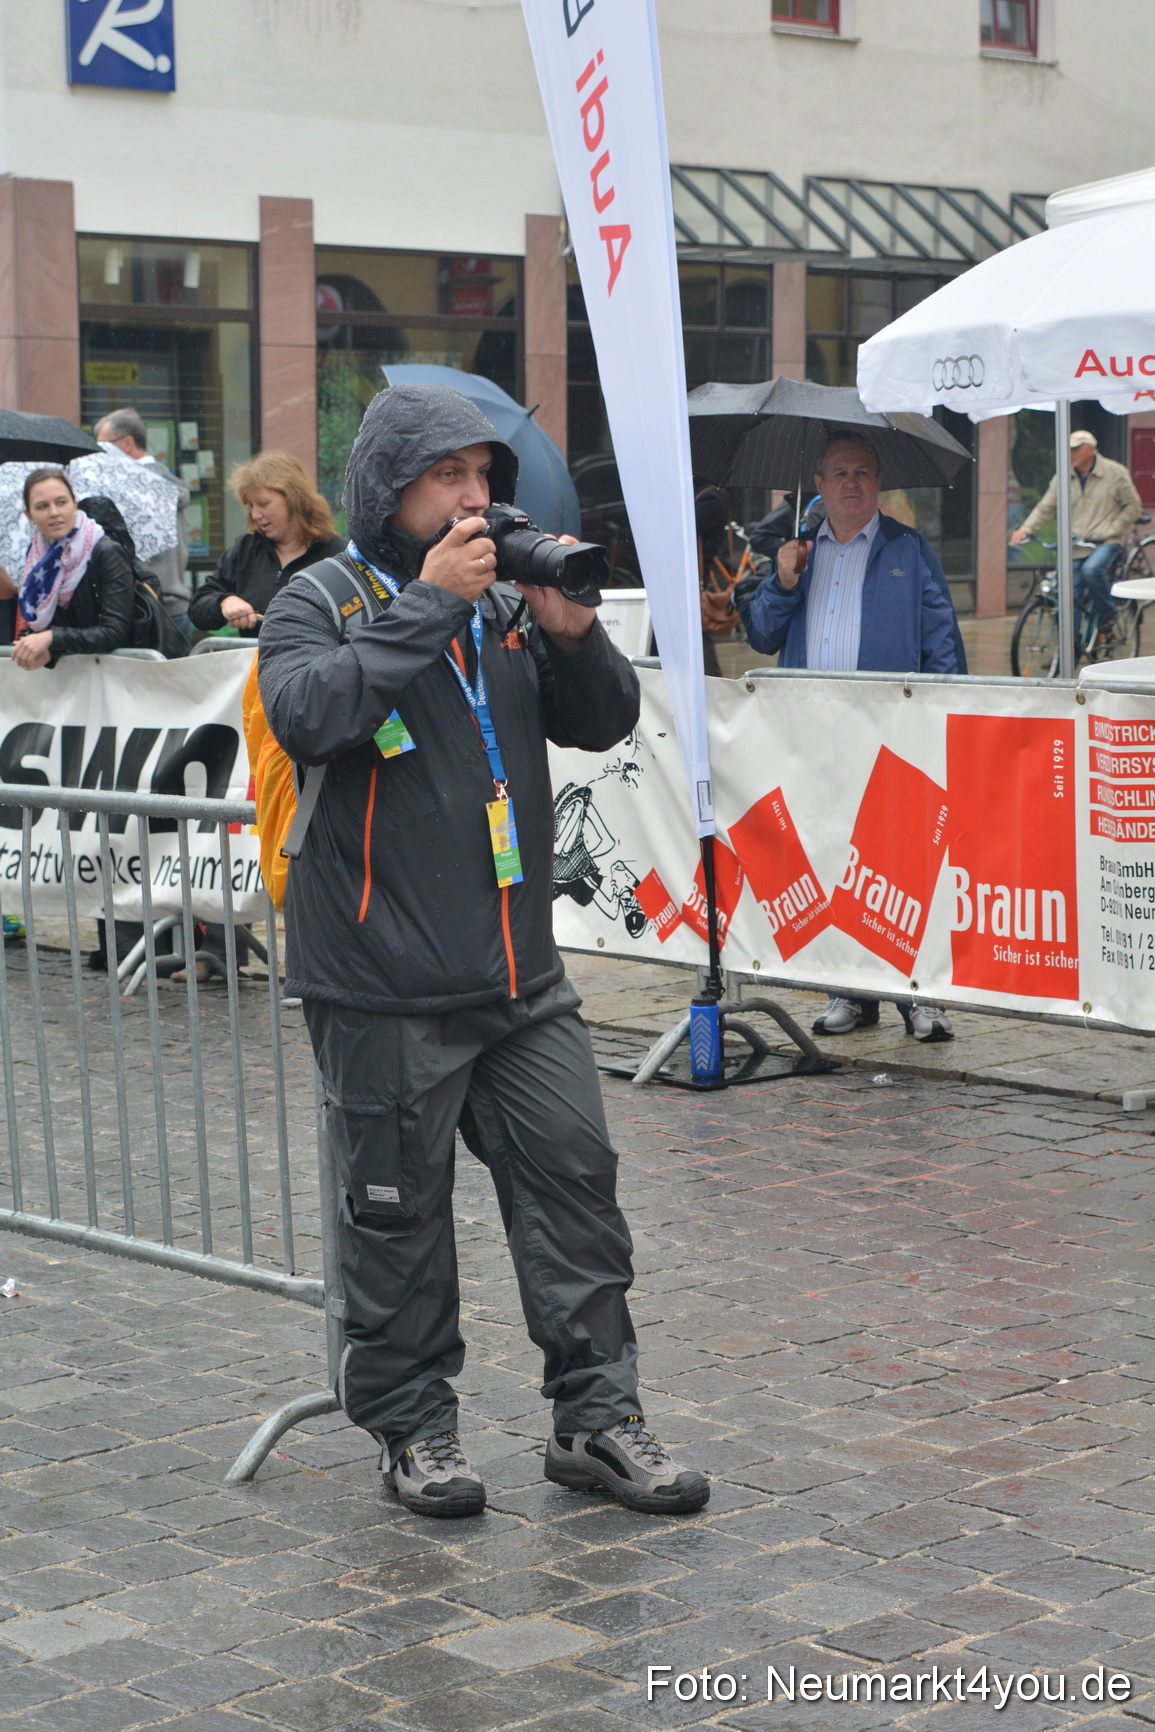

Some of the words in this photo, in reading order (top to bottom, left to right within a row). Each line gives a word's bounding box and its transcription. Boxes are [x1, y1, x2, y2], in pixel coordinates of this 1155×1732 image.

[365, 570, 390, 599] Nikon
[1054, 739, 1064, 769] 1929
[1054, 775, 1064, 798] Seit
[771, 800, 782, 817] 1929
[937, 804, 949, 827] 1929
[932, 828, 943, 846] Seit
[1100, 855, 1117, 875] Bran
[1117, 861, 1154, 878] GmbH
[842, 844, 922, 937] Braun
[1100, 875, 1112, 894] Am
[1113, 879, 1155, 903] Gnberg
[650, 901, 677, 932] Braun
[686, 881, 728, 933] Bran
[758, 873, 819, 937] Braun
[949, 866, 1067, 943] Braun
[792, 914, 809, 933] Sicher
[861, 912, 886, 934] Sicher
[886, 929, 896, 943] ist
[895, 937, 920, 958] sicher
[1101, 925, 1115, 943] Tel.
[1116, 929, 1133, 949] 0981
[993, 945, 1021, 964] Sicher
[1025, 949, 1041, 966] ist
[1045, 951, 1079, 969] sicher
[1102, 946, 1115, 964] Fax
[1117, 950, 1134, 970] 0981
